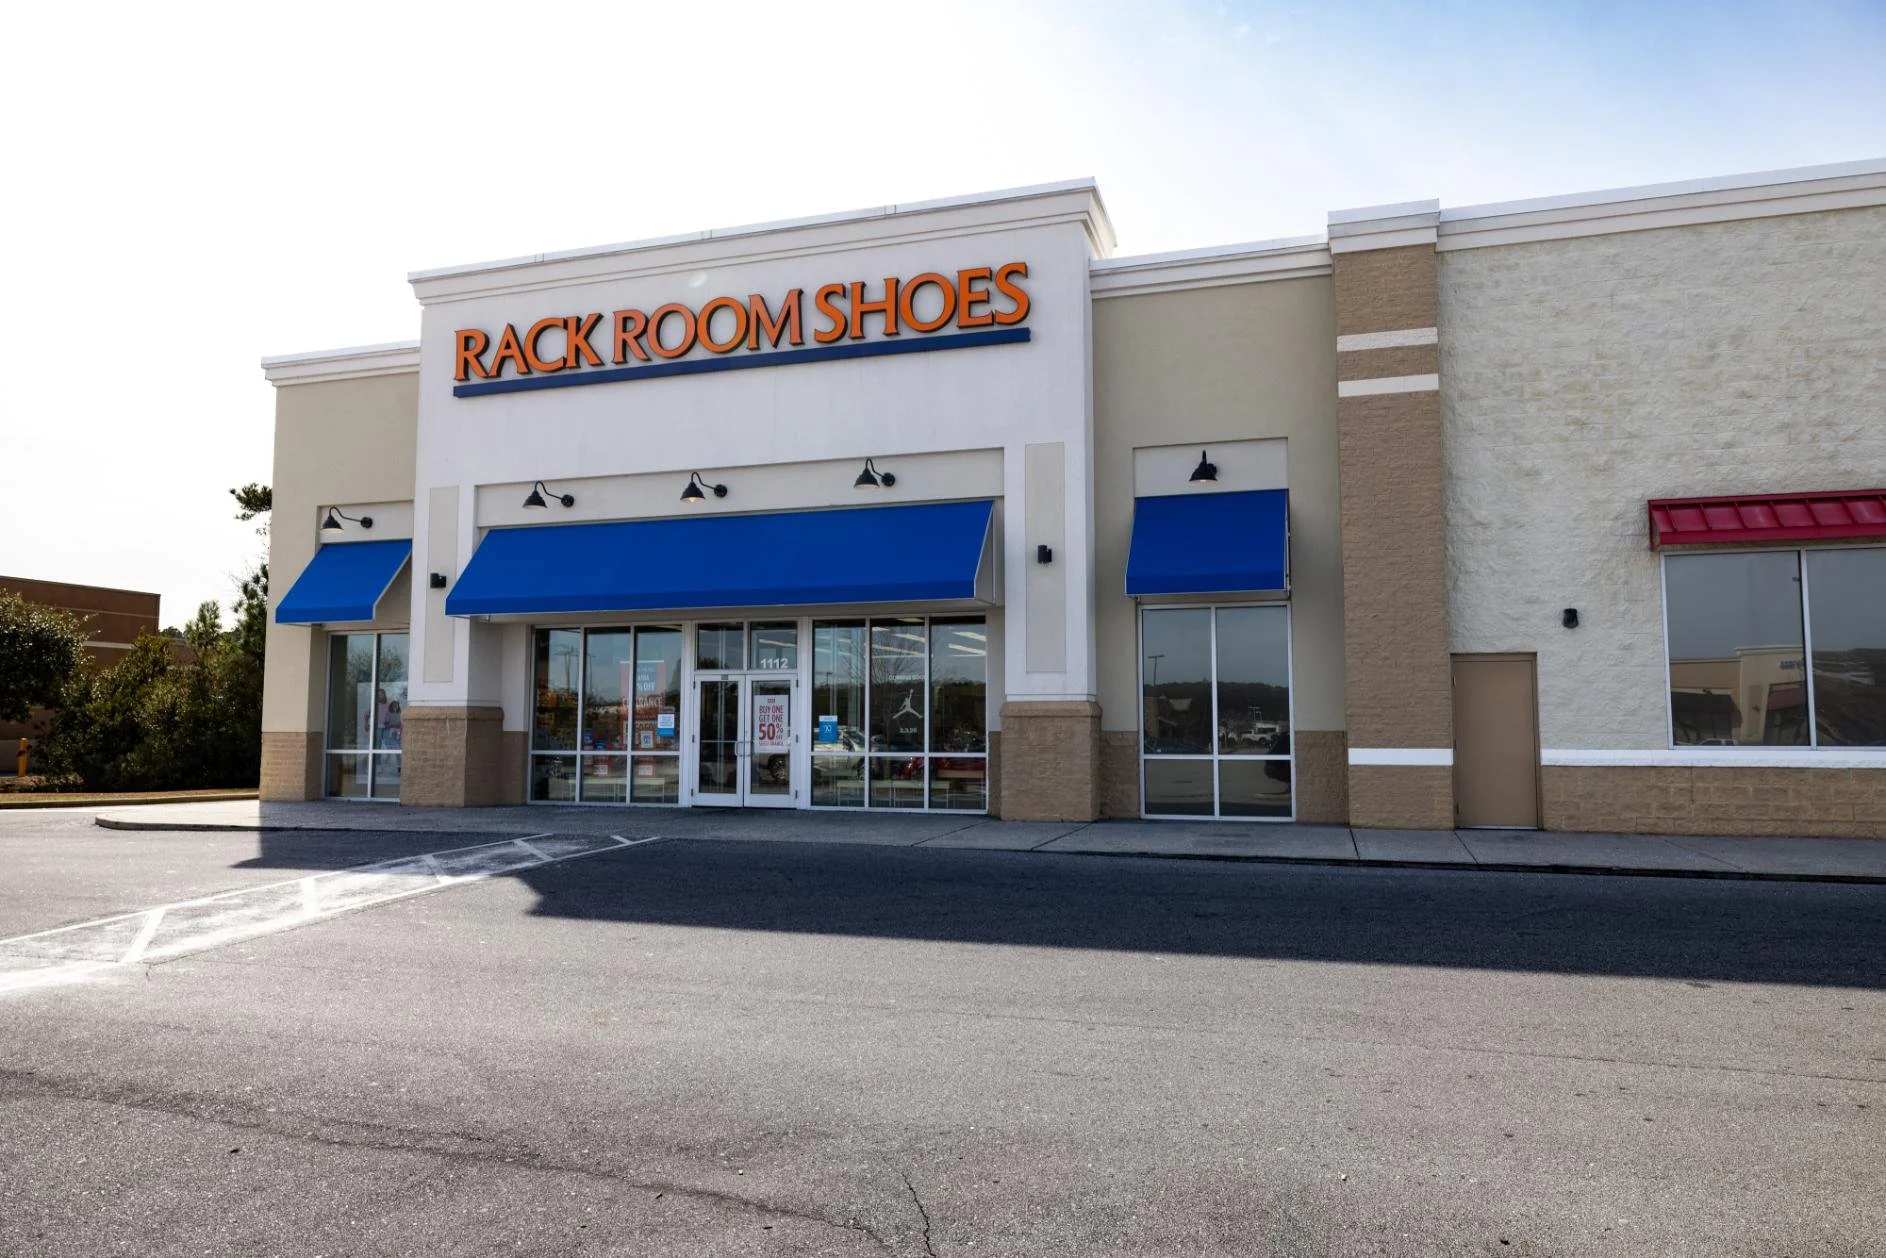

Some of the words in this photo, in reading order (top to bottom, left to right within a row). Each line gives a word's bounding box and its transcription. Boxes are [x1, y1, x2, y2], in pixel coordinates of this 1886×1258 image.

[454, 313, 603, 381] RACK
[612, 288, 804, 364] ROOM
[814, 262, 1031, 343] SHOES
[760, 658, 788, 669] 1112
[759, 705, 771, 714] BUY
[772, 704, 784, 714] ONE
[759, 714, 770, 722] GET
[772, 714, 784, 722] ONE
